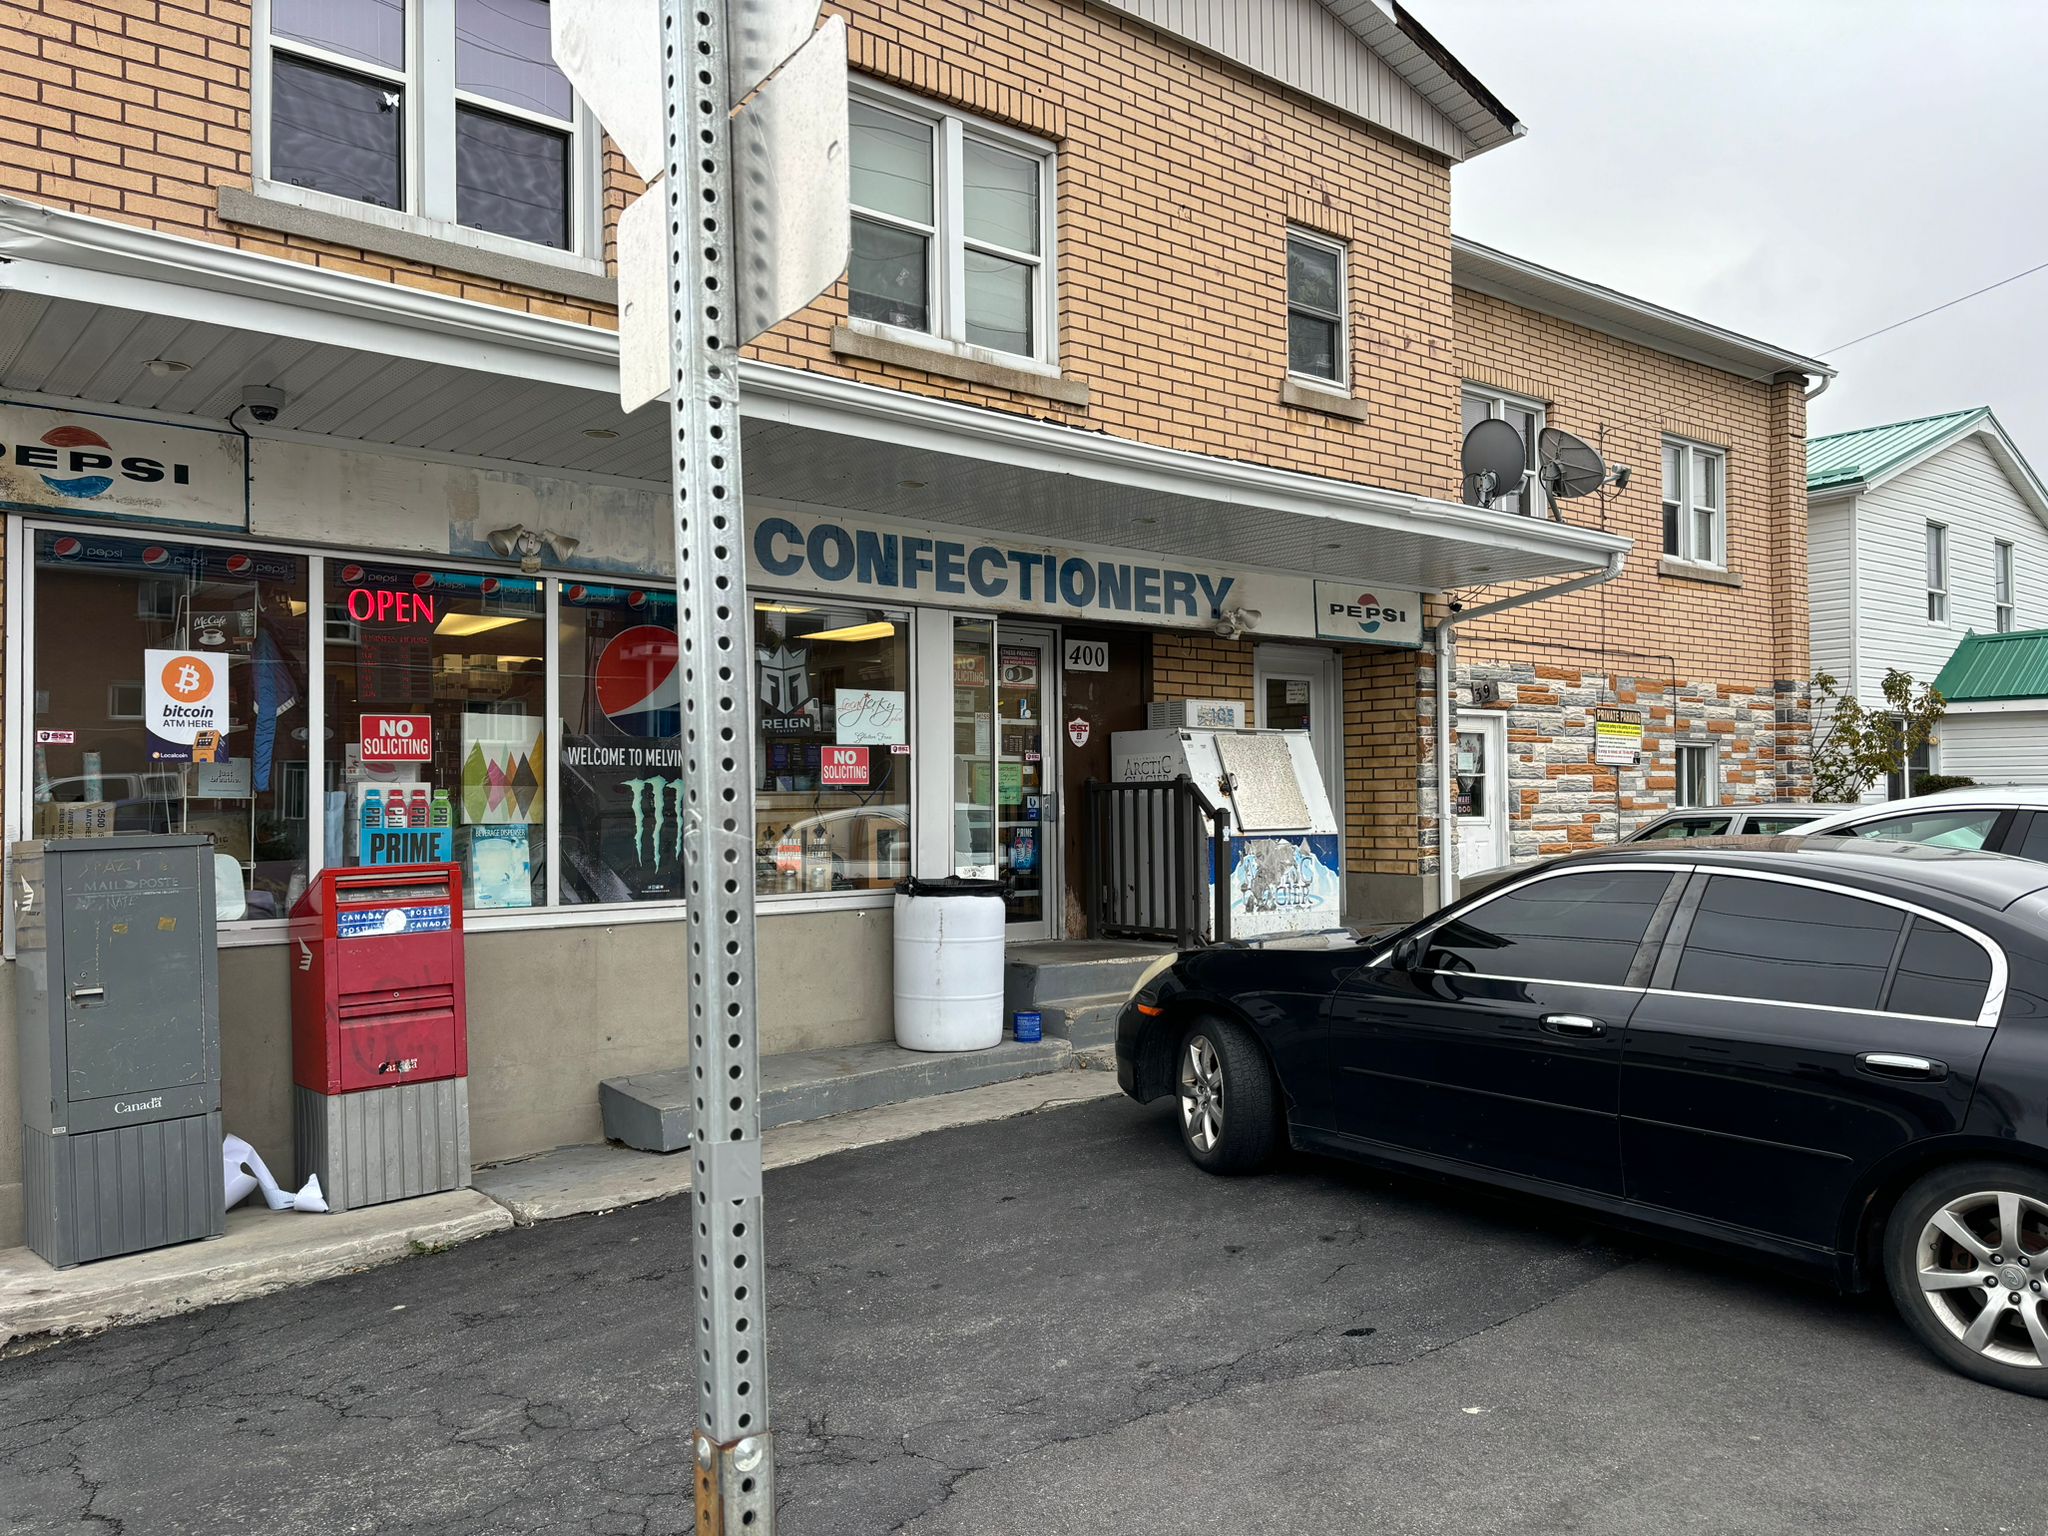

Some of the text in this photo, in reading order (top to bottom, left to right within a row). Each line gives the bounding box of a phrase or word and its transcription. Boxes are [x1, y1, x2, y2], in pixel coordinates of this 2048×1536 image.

[0, 443, 189, 485] EPSI
[86, 547, 123, 559] pepsi
[173, 555, 208, 567] pepsi
[256, 563, 289, 574] pepsi
[754, 517, 1235, 619] CONFECTIONERY
[367, 573, 398, 583] pepsi
[348, 588, 434, 625] OPEN
[1329, 603, 1406, 623] PEPSI
[1069, 645, 1105, 667] 400
[1474, 684, 1491, 702] 39
[163, 705, 214, 718] bitcoin
[1597, 709, 1641, 724] PRIVATE PARKING
[162, 720, 214, 728] ATM HERE
[379, 719, 414, 738] NO
[762, 717, 811, 730] REIGN
[1070, 724, 1089, 733] SSI
[364, 738, 429, 755] SOLICITING
[568, 746, 626, 766] WELCOME
[628, 748, 643, 766] TO
[834, 751, 857, 766] NO
[823, 765, 867, 780] SOLICITING
[1124, 755, 1172, 776] ARCTIC
[1457, 805, 1471, 813] DOG
[1016, 827, 1033, 838] PRIME
[370, 832, 442, 864] PRIME
[84, 877, 179, 892] MAIL POSTE
[341, 912, 382, 921] CANADA
[410, 908, 443, 918] POSTES
[410, 920, 447, 929] CANADA
[114, 1096, 162, 1114] Canada
